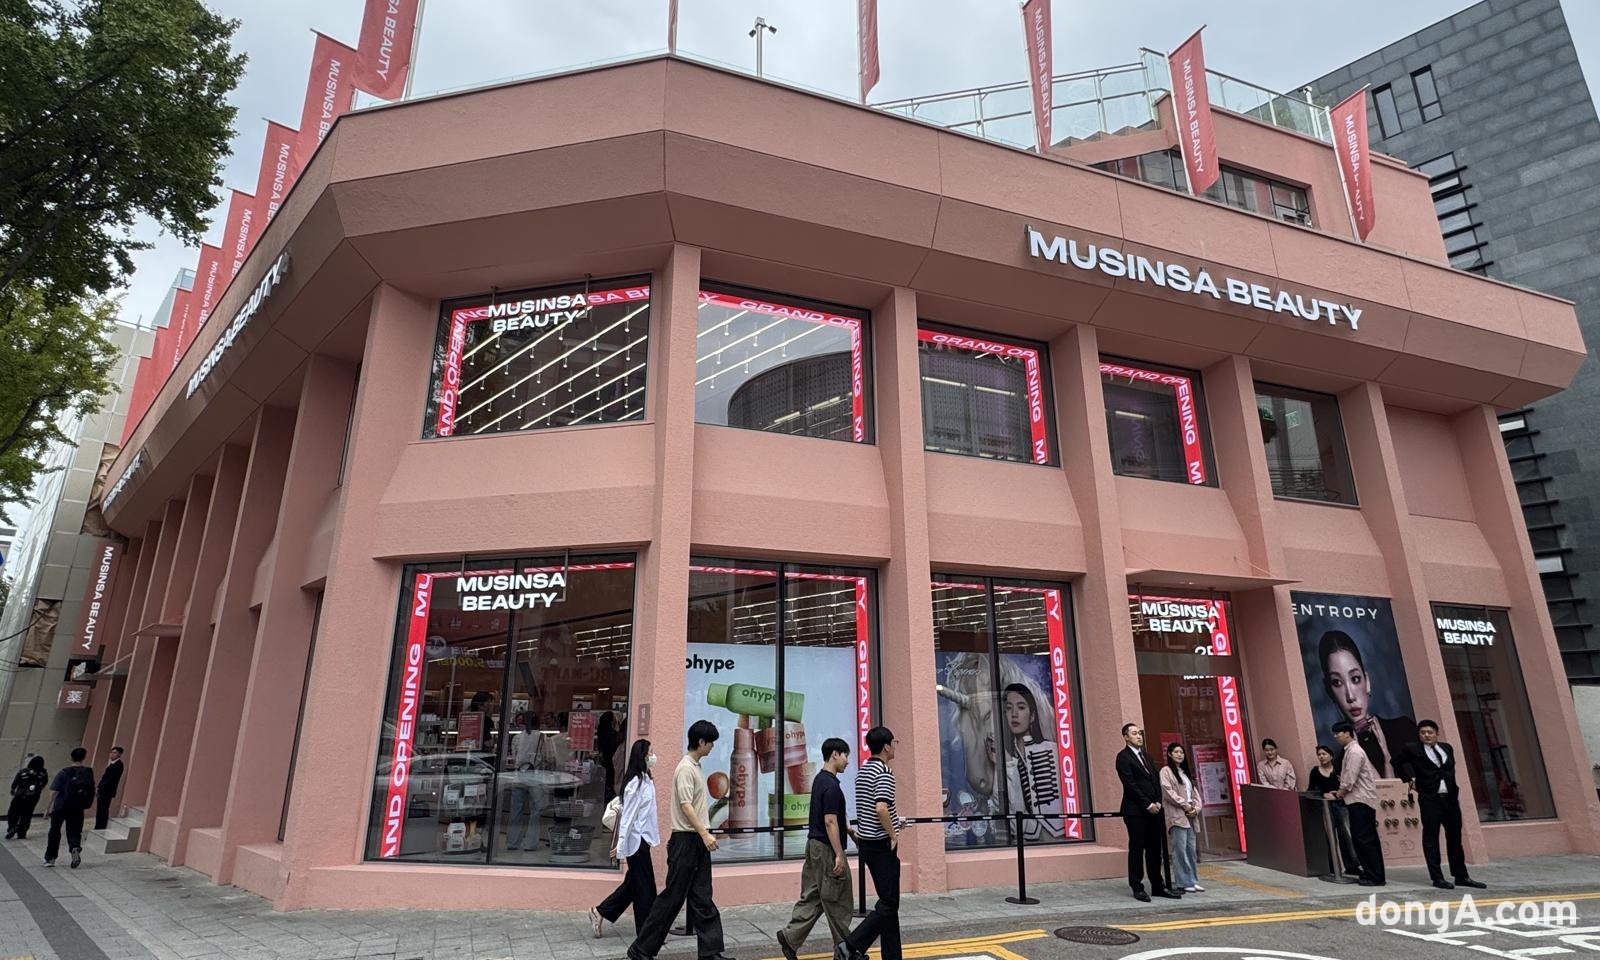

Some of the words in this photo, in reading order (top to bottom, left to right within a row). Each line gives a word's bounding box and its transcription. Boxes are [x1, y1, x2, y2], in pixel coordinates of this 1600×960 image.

[376, 16, 397, 80] BEAUTY
[1034, 7, 1047, 74] MUSINSA
[321, 59, 341, 119] MUSINSA
[1040, 72, 1050, 128] BEAUTY
[1183, 58, 1197, 120] MUSINSA
[1190, 120, 1204, 172] BEAUTY
[1345, 114, 1360, 172] MUSINSA
[271, 143, 290, 200] MUSINSA
[235, 208, 252, 259] MUSINSA
[487, 293, 587, 318] MUSINSA
[1029, 229, 1221, 299] MUSINSA
[1226, 277, 1362, 330] BEAUTY
[493, 310, 578, 333] BEAUTY
[739, 300, 825, 321] GRAND
[828, 317, 862, 397] OPENING
[932, 334, 1005, 352] GRAND
[1007, 348, 1042, 423] OPENING
[1100, 364, 1160, 380] GRAND
[1161, 376, 1196, 446] OPENING
[440, 389, 454, 436] AND
[93, 546, 114, 600] MUSINSA
[456, 573, 567, 593] MUSINSA
[82, 601, 100, 650] BEAUTY
[462, 592, 558, 612] BEAUTY
[1142, 602, 1220, 619] MUSINSA
[1149, 619, 1217, 634] BEAUTY
[1437, 618, 1496, 633] MUSINSA
[1444, 632, 1493, 646] BEAUTY
[394, 643, 421, 786] OPENING
[859, 640, 869, 752] GRAND
[1054, 647, 1071, 749] GRAND
[736, 765, 748, 808] ohype
